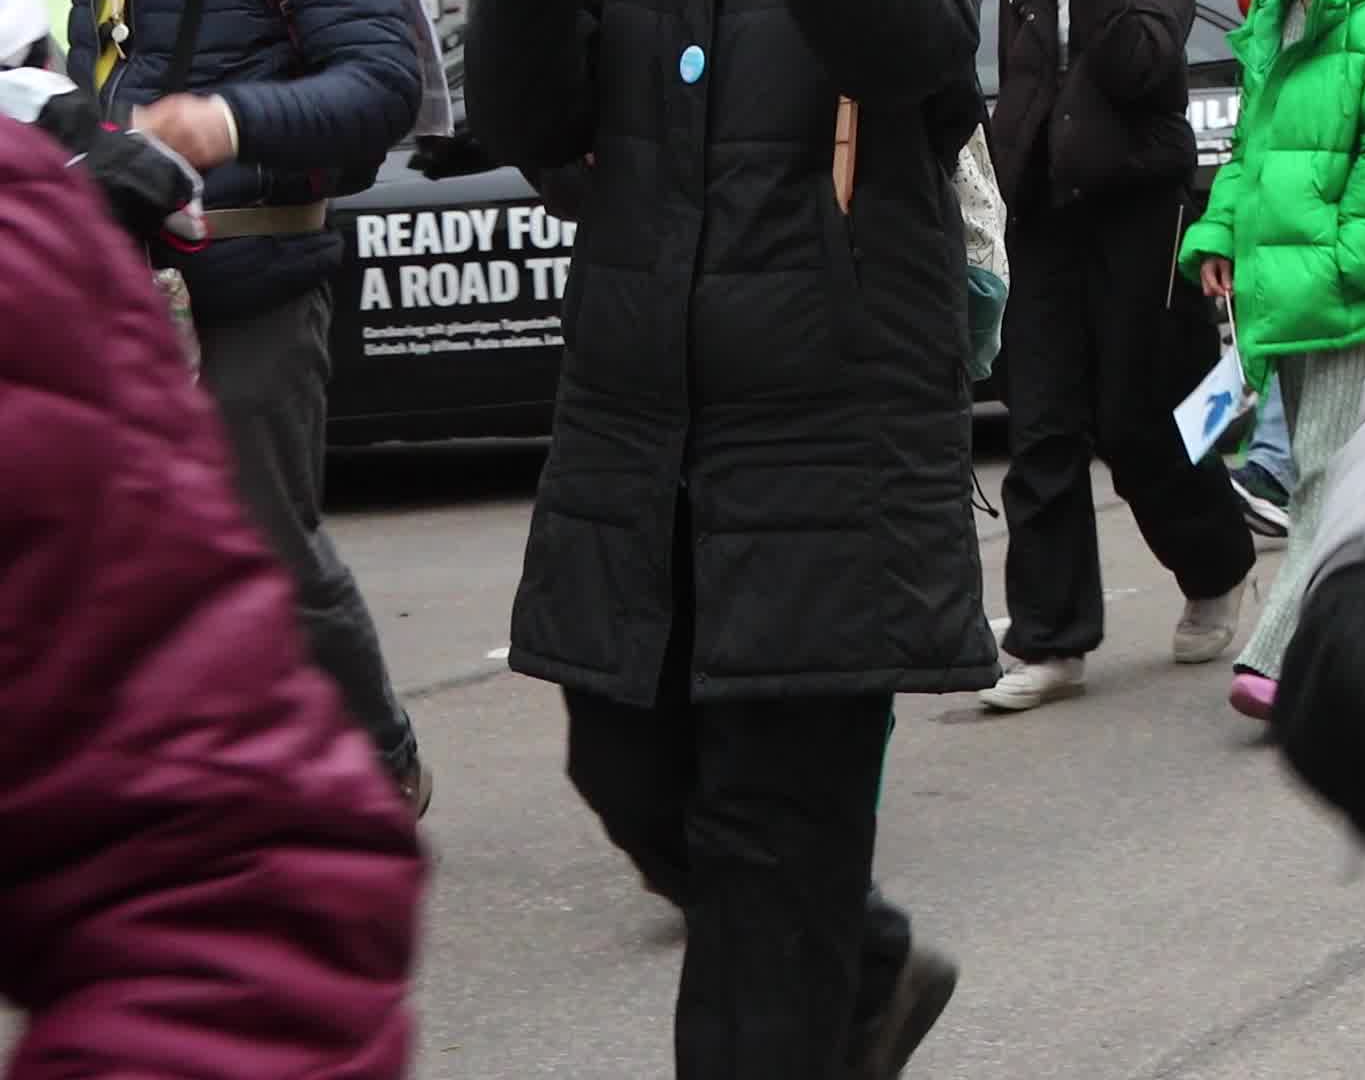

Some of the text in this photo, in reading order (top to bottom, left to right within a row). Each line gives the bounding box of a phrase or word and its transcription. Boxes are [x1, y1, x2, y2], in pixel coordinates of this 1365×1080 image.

[356, 208, 499, 258] READY
[360, 267, 393, 311] A
[399, 260, 520, 309] ROAD
